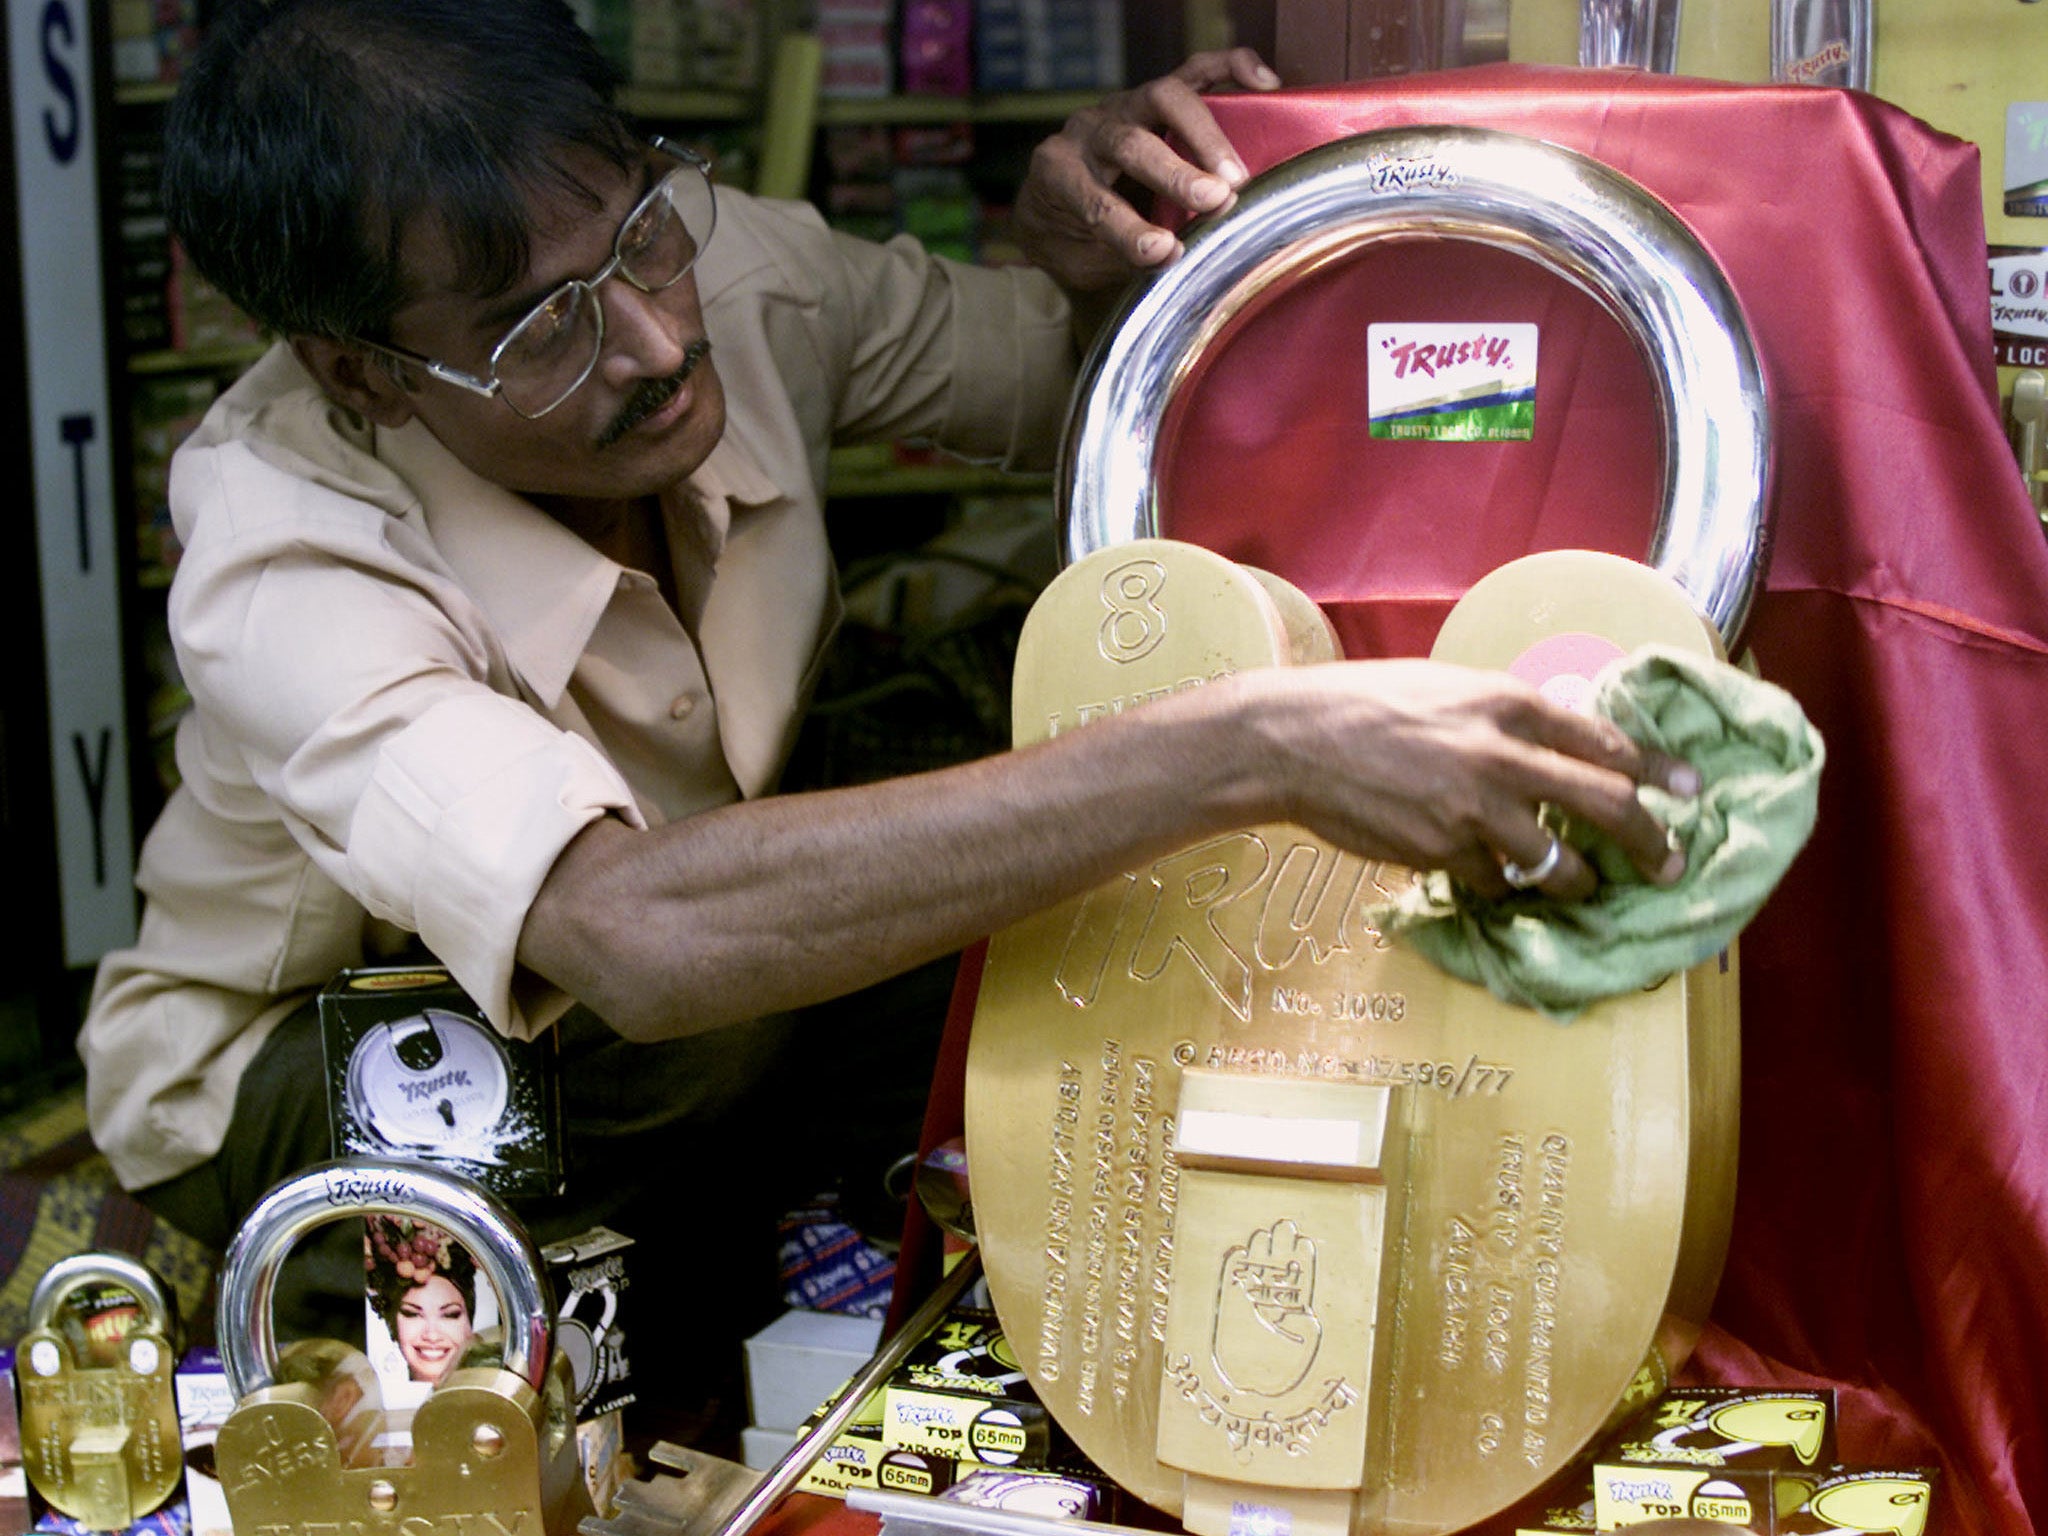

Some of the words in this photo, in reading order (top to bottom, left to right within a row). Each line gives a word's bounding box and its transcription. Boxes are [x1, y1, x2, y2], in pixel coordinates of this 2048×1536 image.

[1391, 424, 1430, 437] TRUSTY
[1098, 559, 1168, 664] 8
[1494, 1133, 1526, 1248] TRUSTY
[1538, 1133, 1573, 1252] QUALITY
[1045, 1195, 1073, 1265] AND
[1484, 1286, 1513, 1374] LOCK
[925, 1426, 962, 1440] TOP
[976, 1429, 1023, 1446] 65mm
[836, 1463, 872, 1479] TOP
[885, 1468, 930, 1487] 65mm
[1641, 1503, 1682, 1516] TOP
[1696, 1501, 1748, 1519] 65mm
